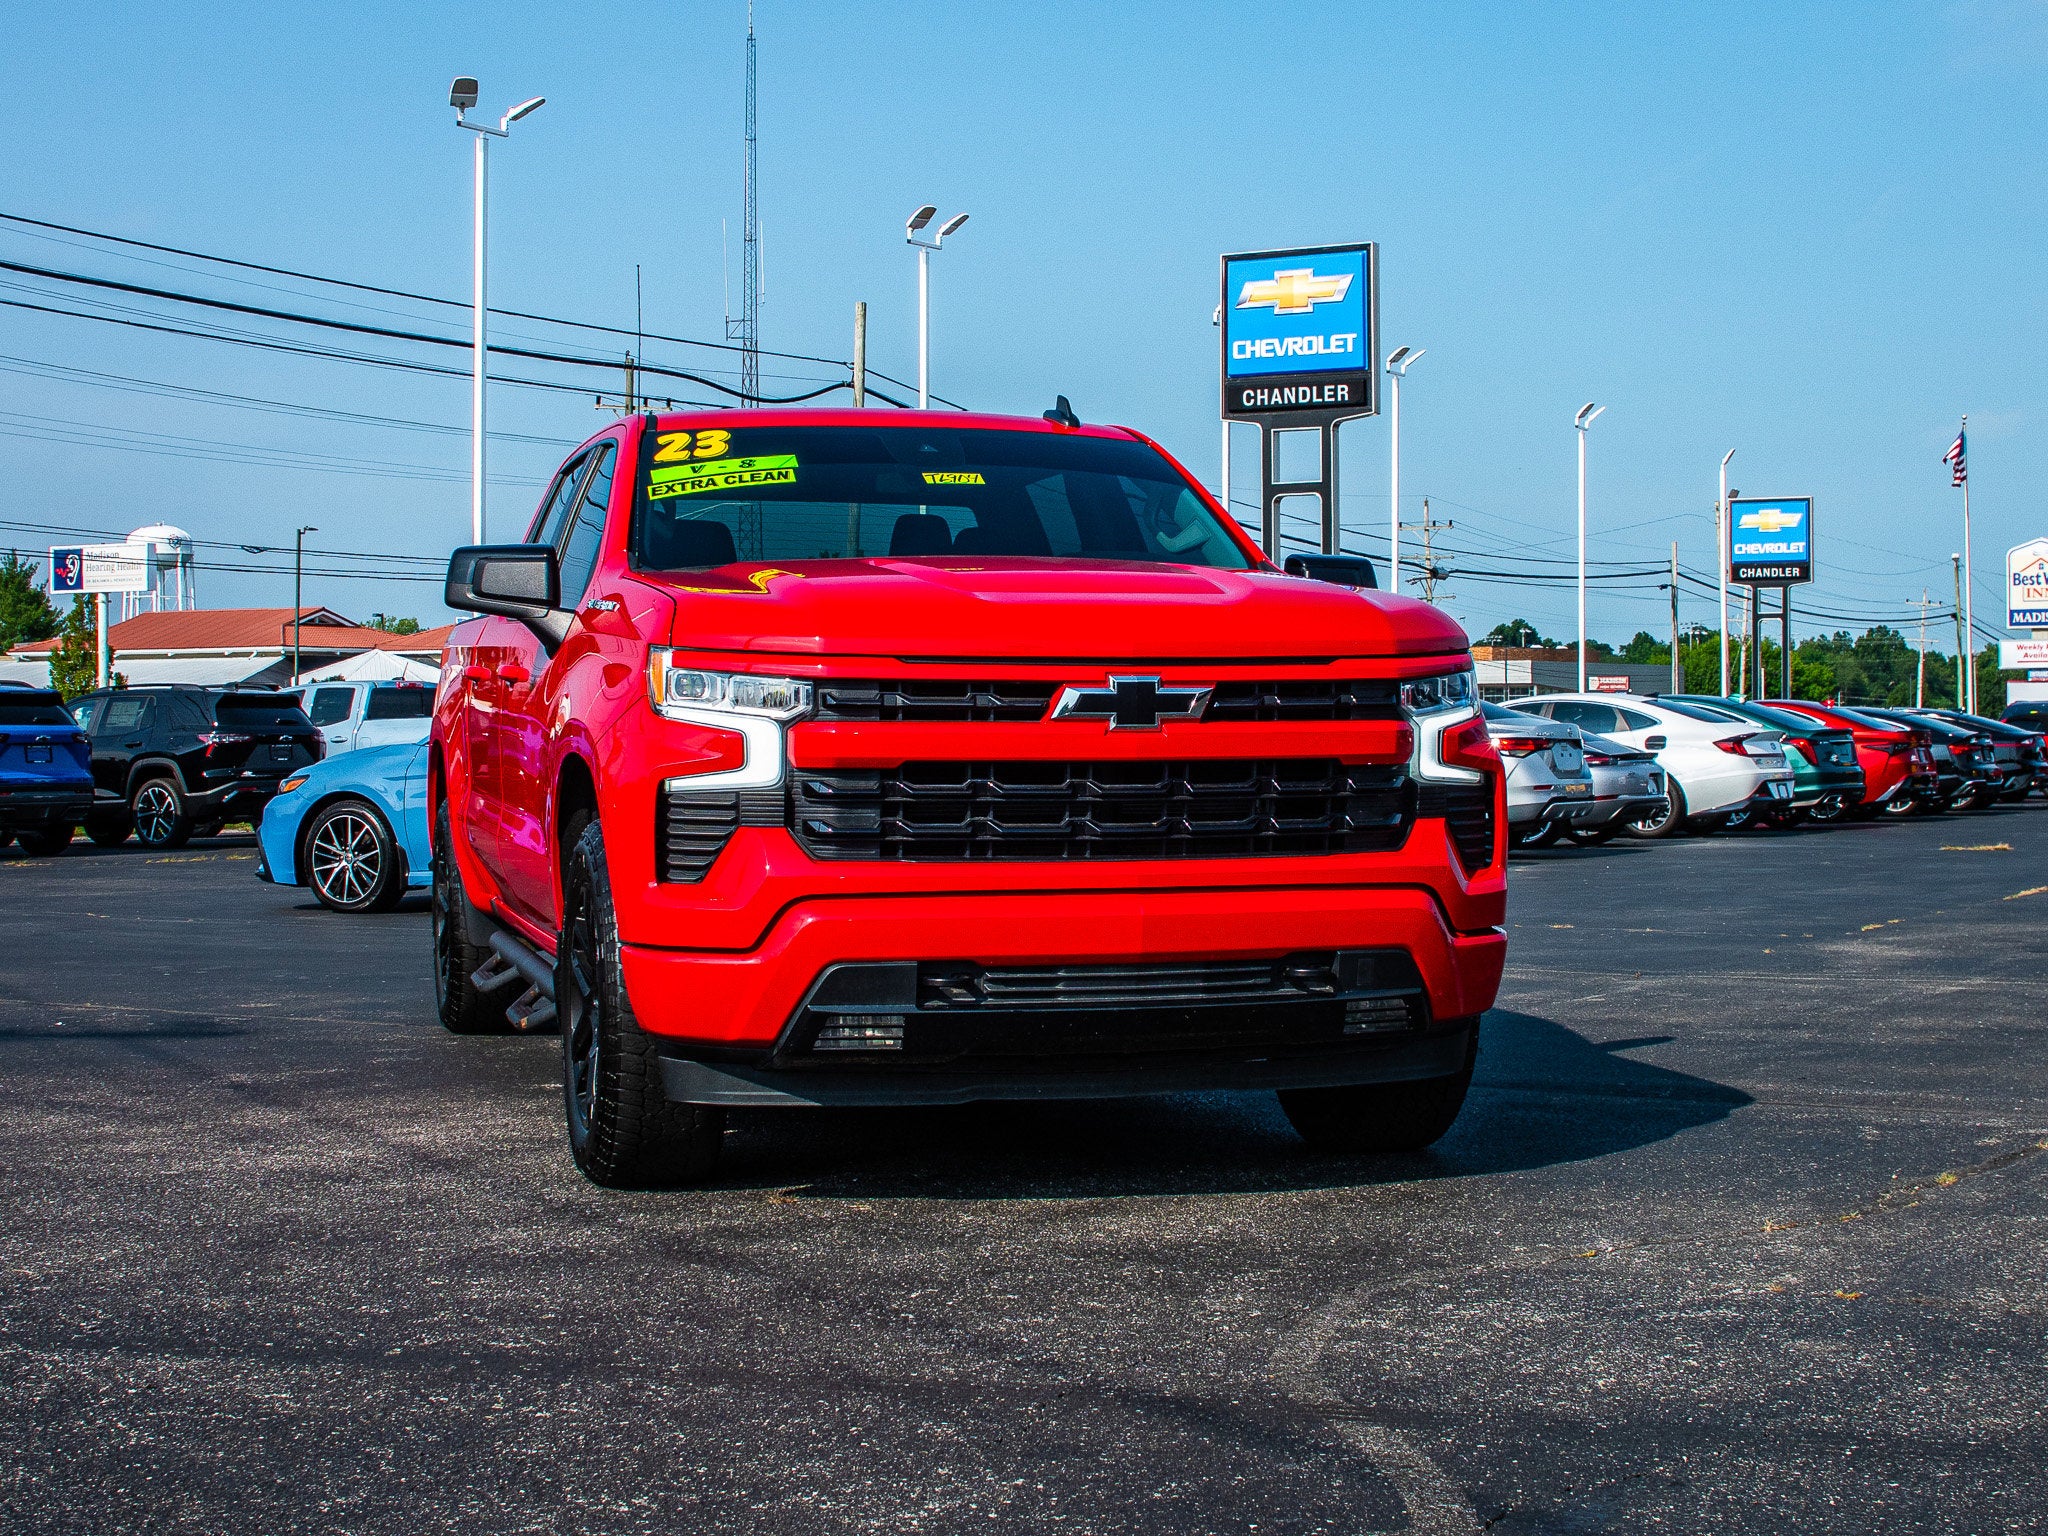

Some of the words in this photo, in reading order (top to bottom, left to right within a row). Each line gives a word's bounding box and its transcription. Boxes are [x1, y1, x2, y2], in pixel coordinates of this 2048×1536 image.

[1232, 333, 1357, 360] CHEVROLET
[1242, 384, 1349, 406] CHANDLER
[653, 429, 732, 462] 23
[651, 478, 719, 497] EXTRA
[724, 470, 791, 485] CLEAN
[1734, 542, 1806, 554] CHEVROLET
[86, 563, 115, 573] Hearing
[1740, 567, 1800, 578] CHANDLER
[2013, 572, 2042, 586] Best
